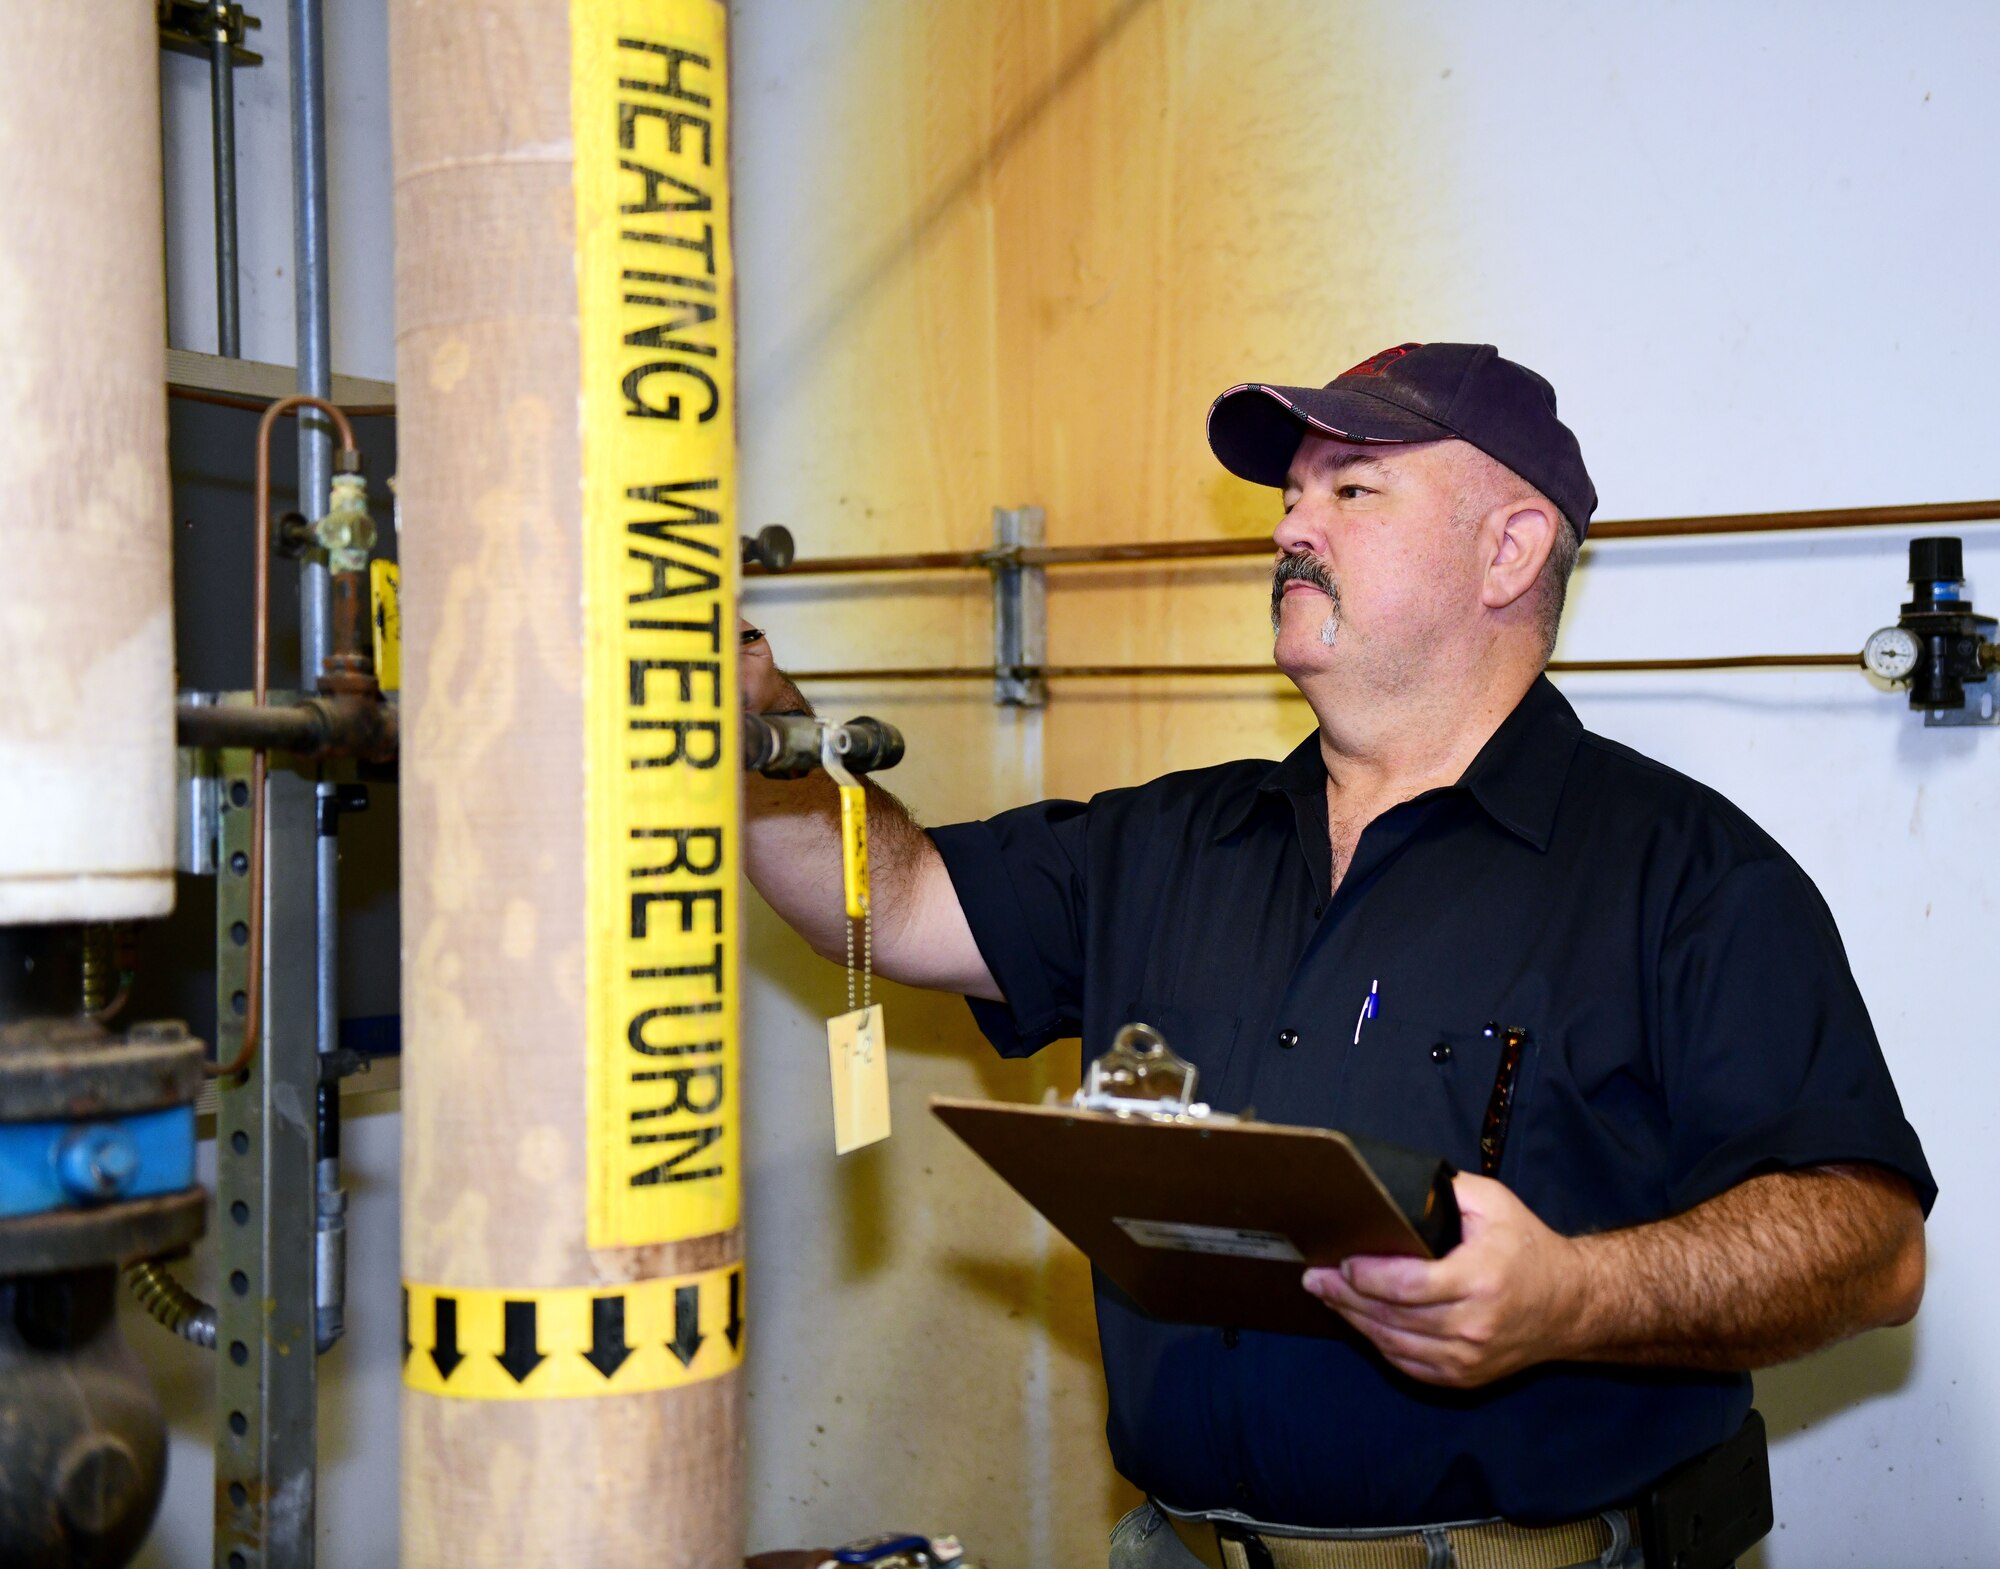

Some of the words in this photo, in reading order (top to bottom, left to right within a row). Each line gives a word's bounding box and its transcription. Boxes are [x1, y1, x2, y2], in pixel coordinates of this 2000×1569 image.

[617, 38, 720, 424] HEATING
[627, 479, 721, 771] WATER
[627, 827, 723, 1187] RETURN
